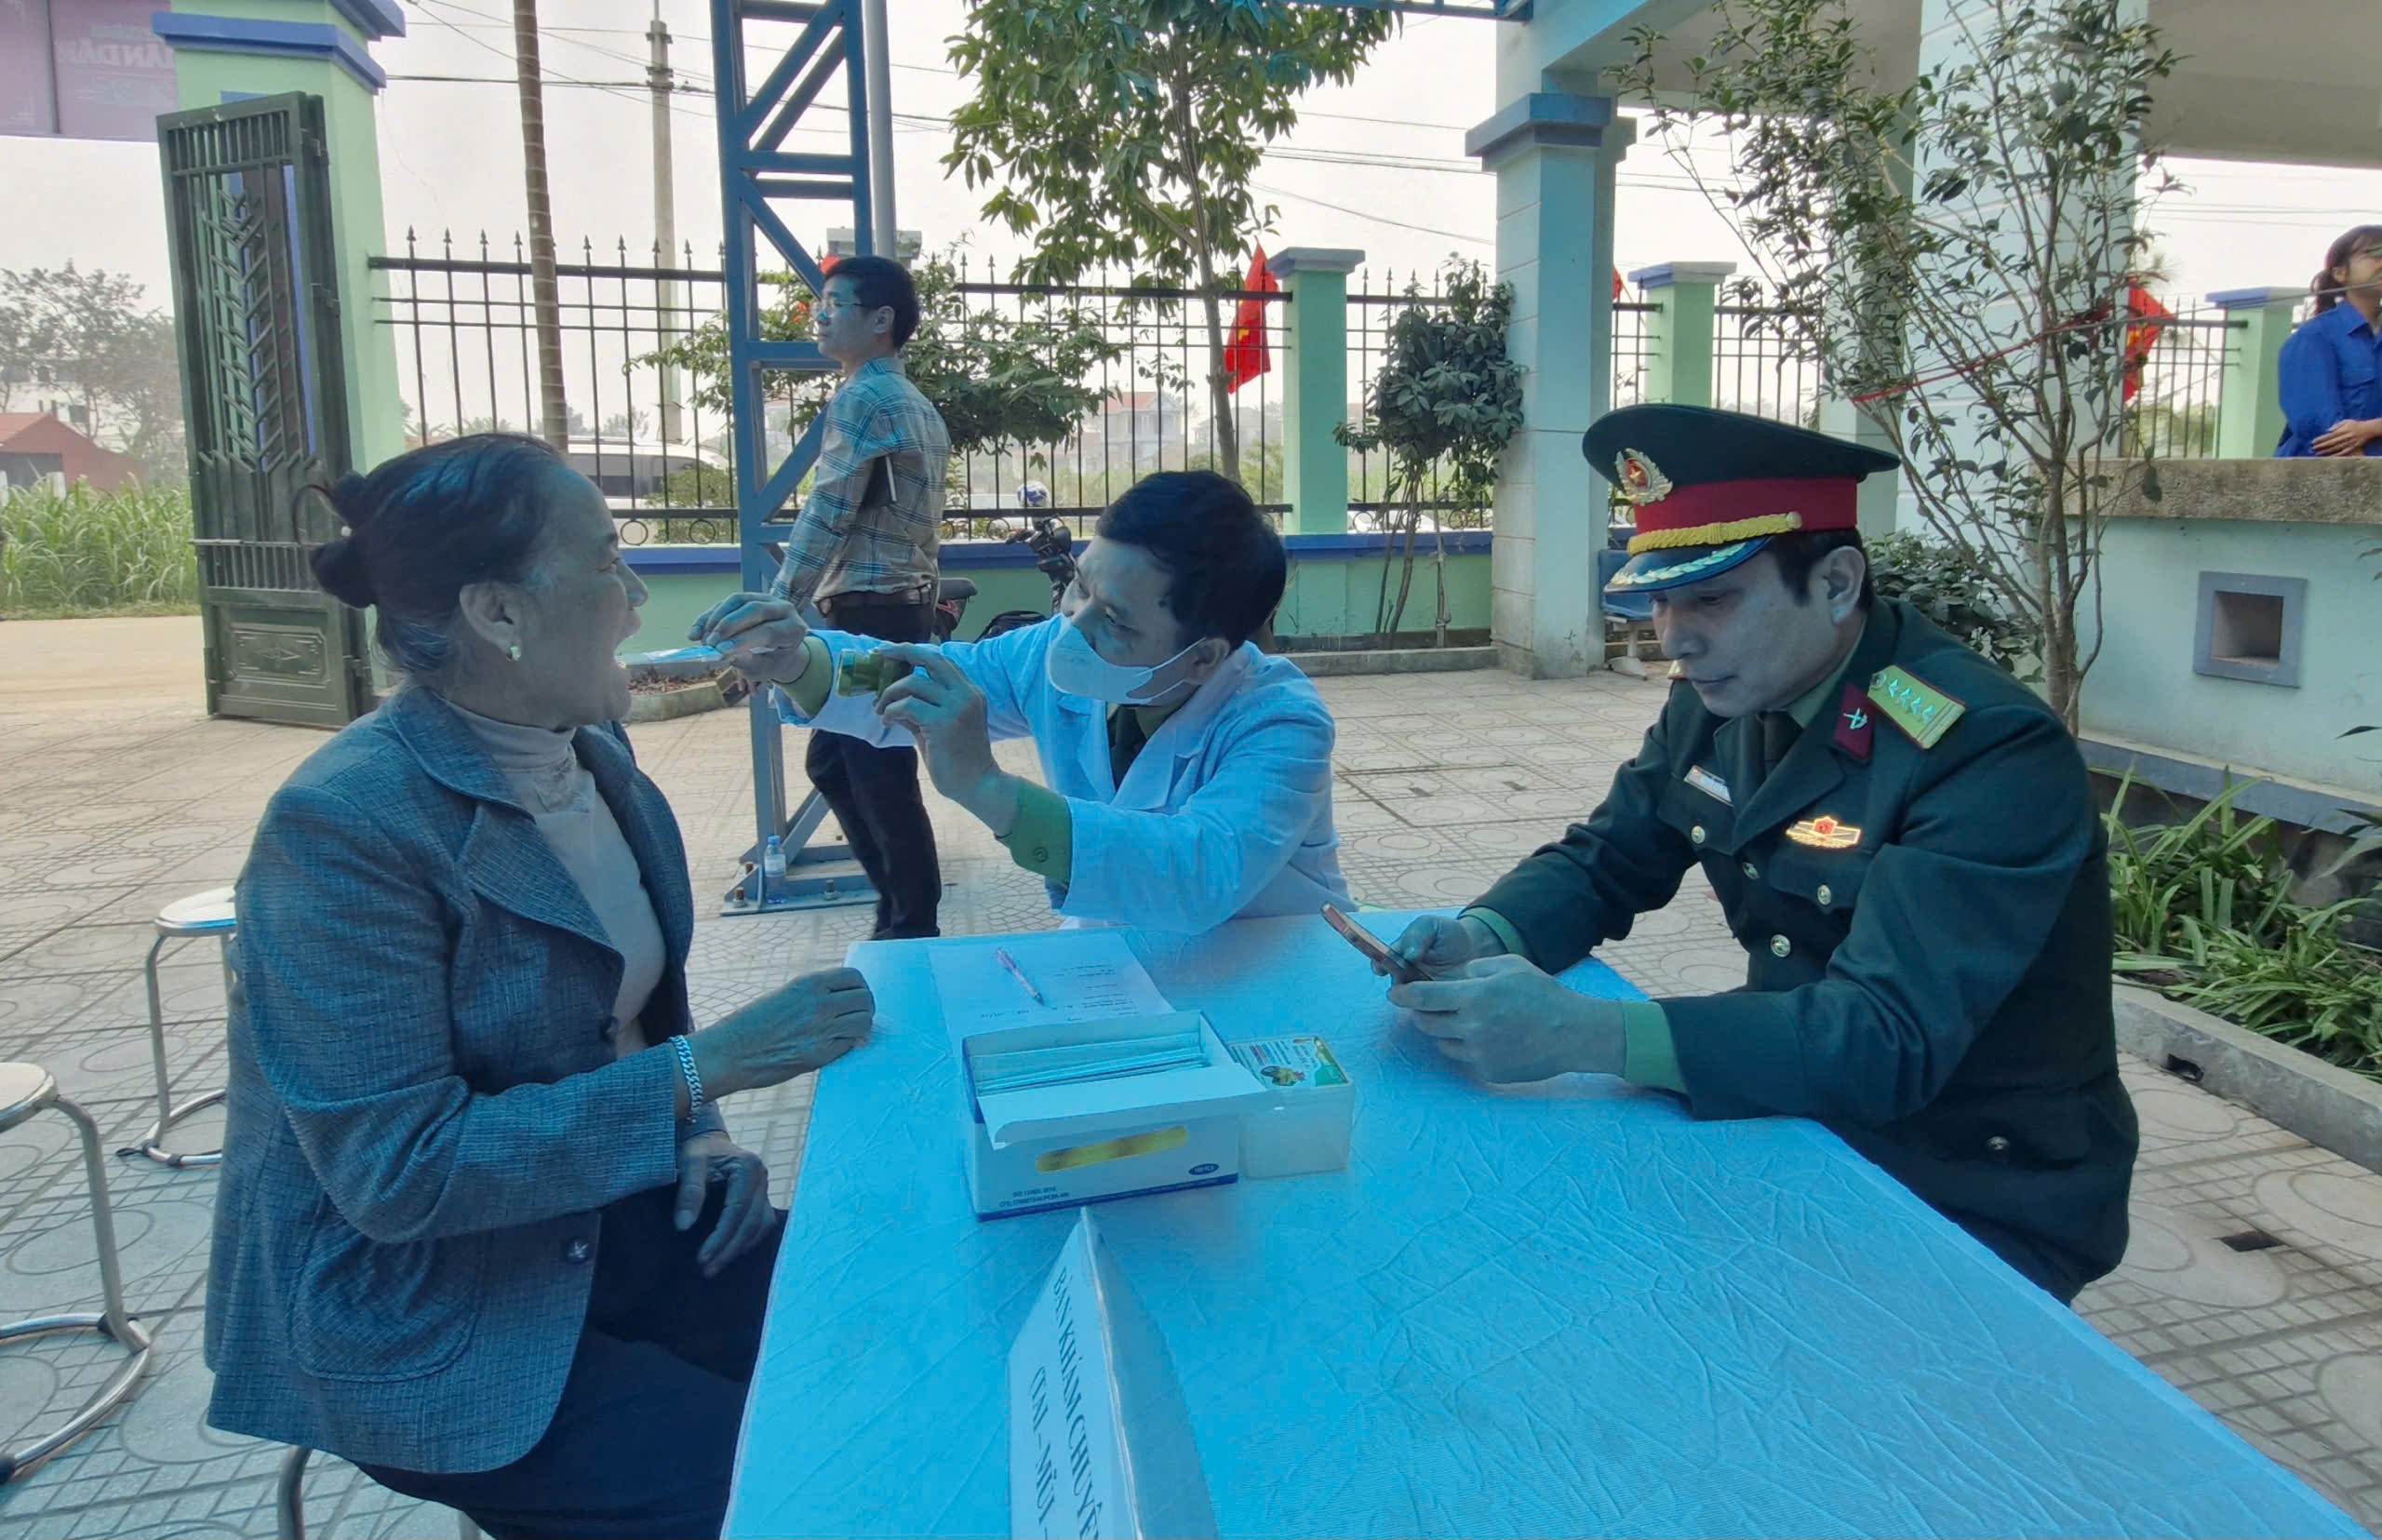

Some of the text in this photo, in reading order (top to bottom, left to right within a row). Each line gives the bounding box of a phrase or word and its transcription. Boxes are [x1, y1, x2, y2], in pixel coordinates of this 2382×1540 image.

[1029, 1366, 1049, 1433] TAI
[1058, 1319, 1083, 1422] KHÁM
[1068, 1414, 1103, 1540] CHUYÊ
